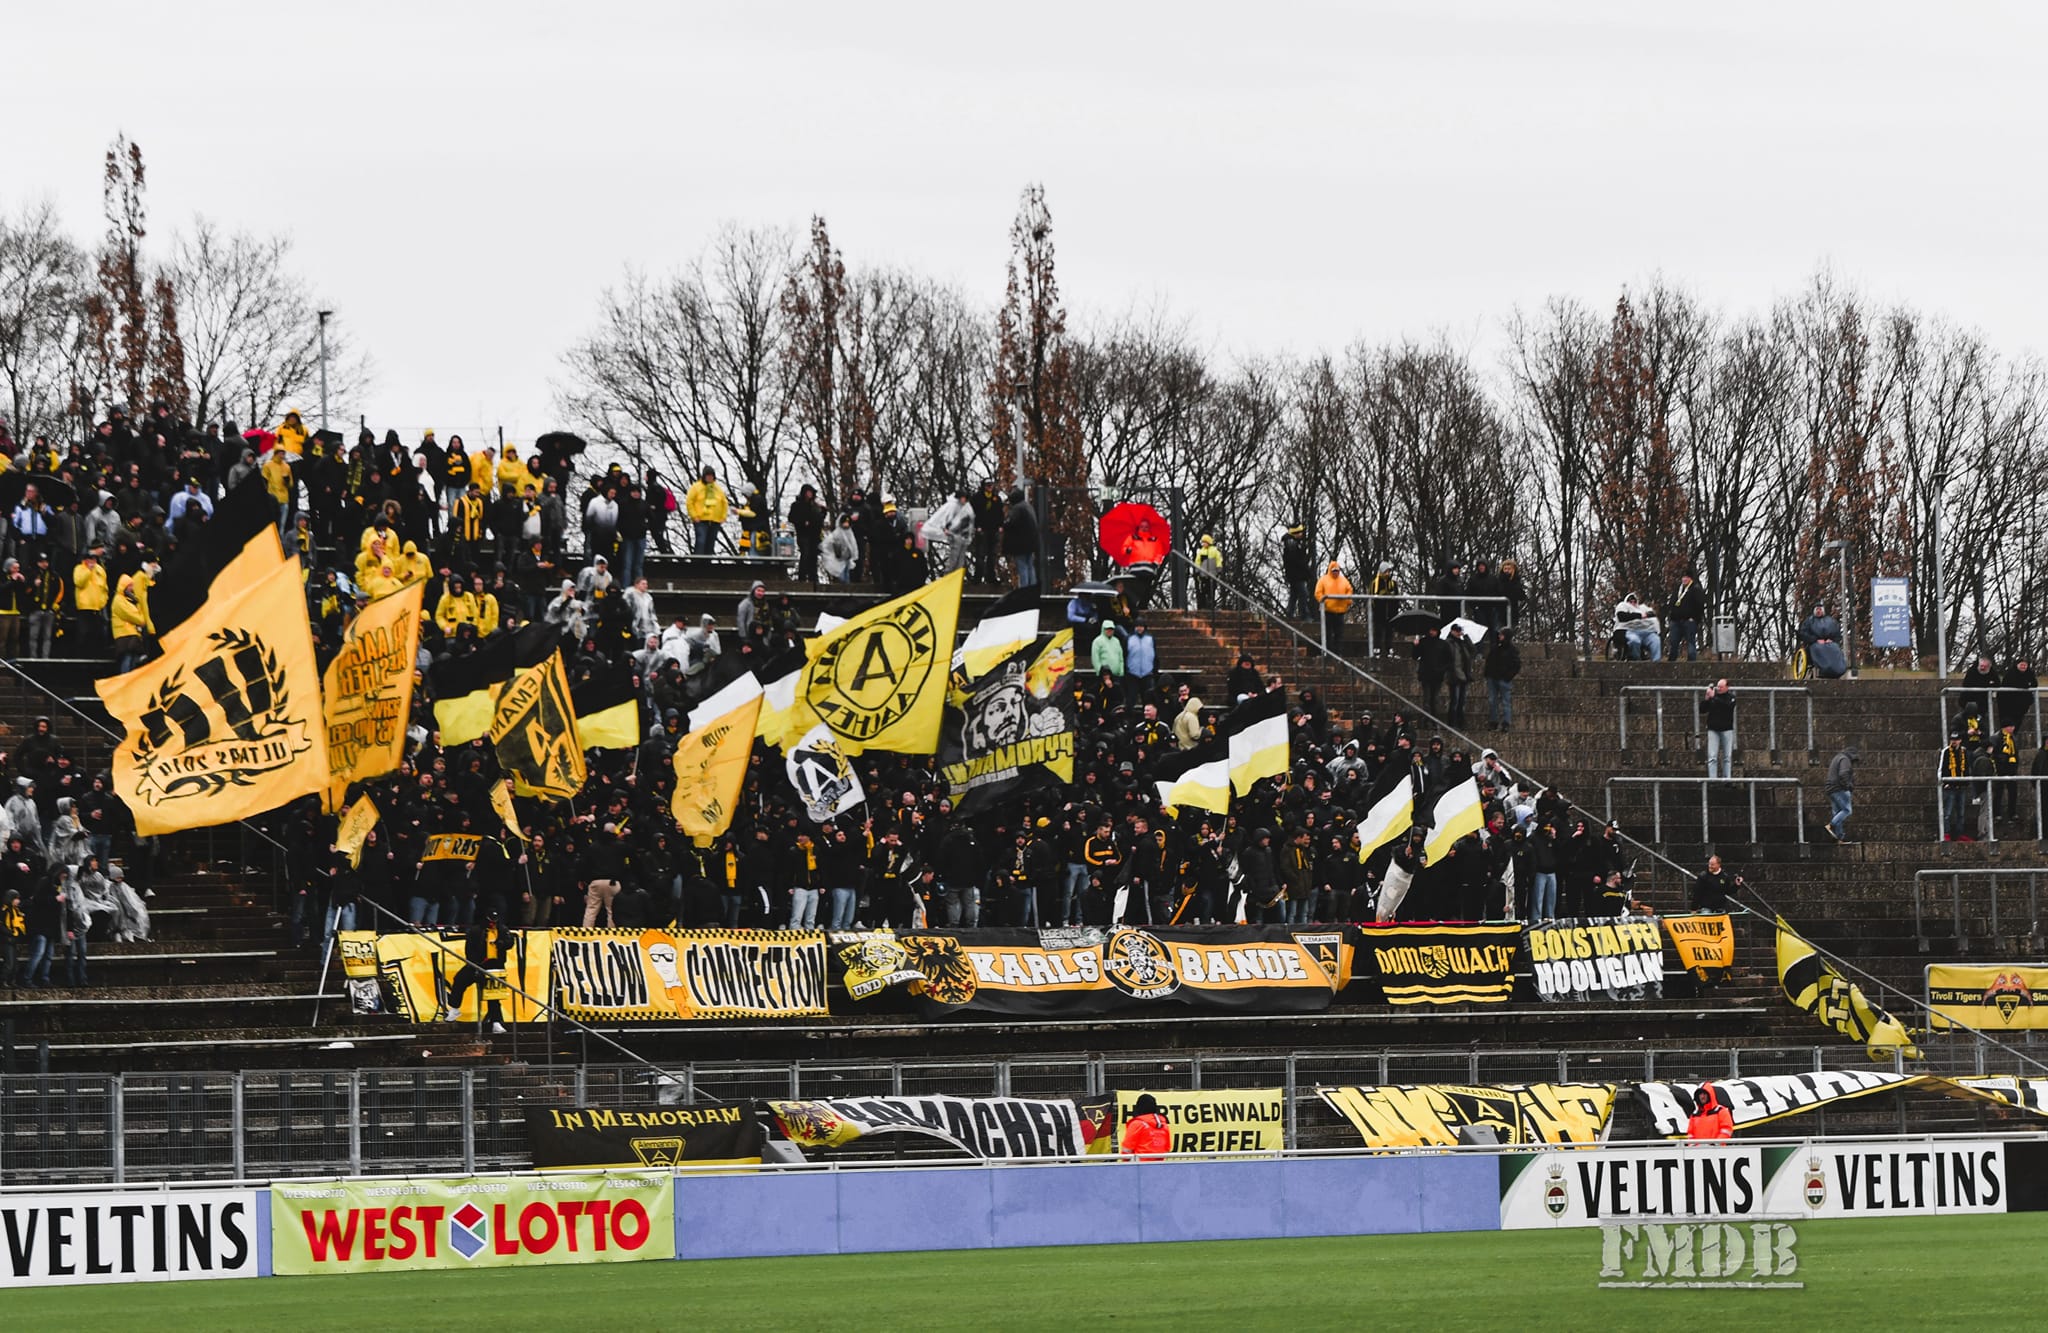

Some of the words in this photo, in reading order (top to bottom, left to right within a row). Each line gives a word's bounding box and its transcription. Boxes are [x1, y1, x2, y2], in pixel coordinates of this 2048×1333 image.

[554, 939, 648, 1007] YELLOW
[686, 942, 826, 1010] CONNECTION
[967, 950, 1100, 986] KARLS
[1177, 948, 1309, 983] BANDE
[852, 979, 882, 996] UND
[1930, 991, 1954, 1001] Tivoli
[1955, 991, 1982, 1003] Tigers
[586, 1106, 743, 1133] MEMORIAM
[1121, 1101, 1281, 1125] HRTGENWALD
[1474, 1099, 1505, 1120] A
[1576, 1156, 1754, 1219] VELTINS
[1834, 1151, 2001, 1210] VELTINS
[1, 1201, 249, 1277] VELTINS
[301, 1205, 446, 1263] WEST
[493, 1198, 651, 1256] LOTTO
